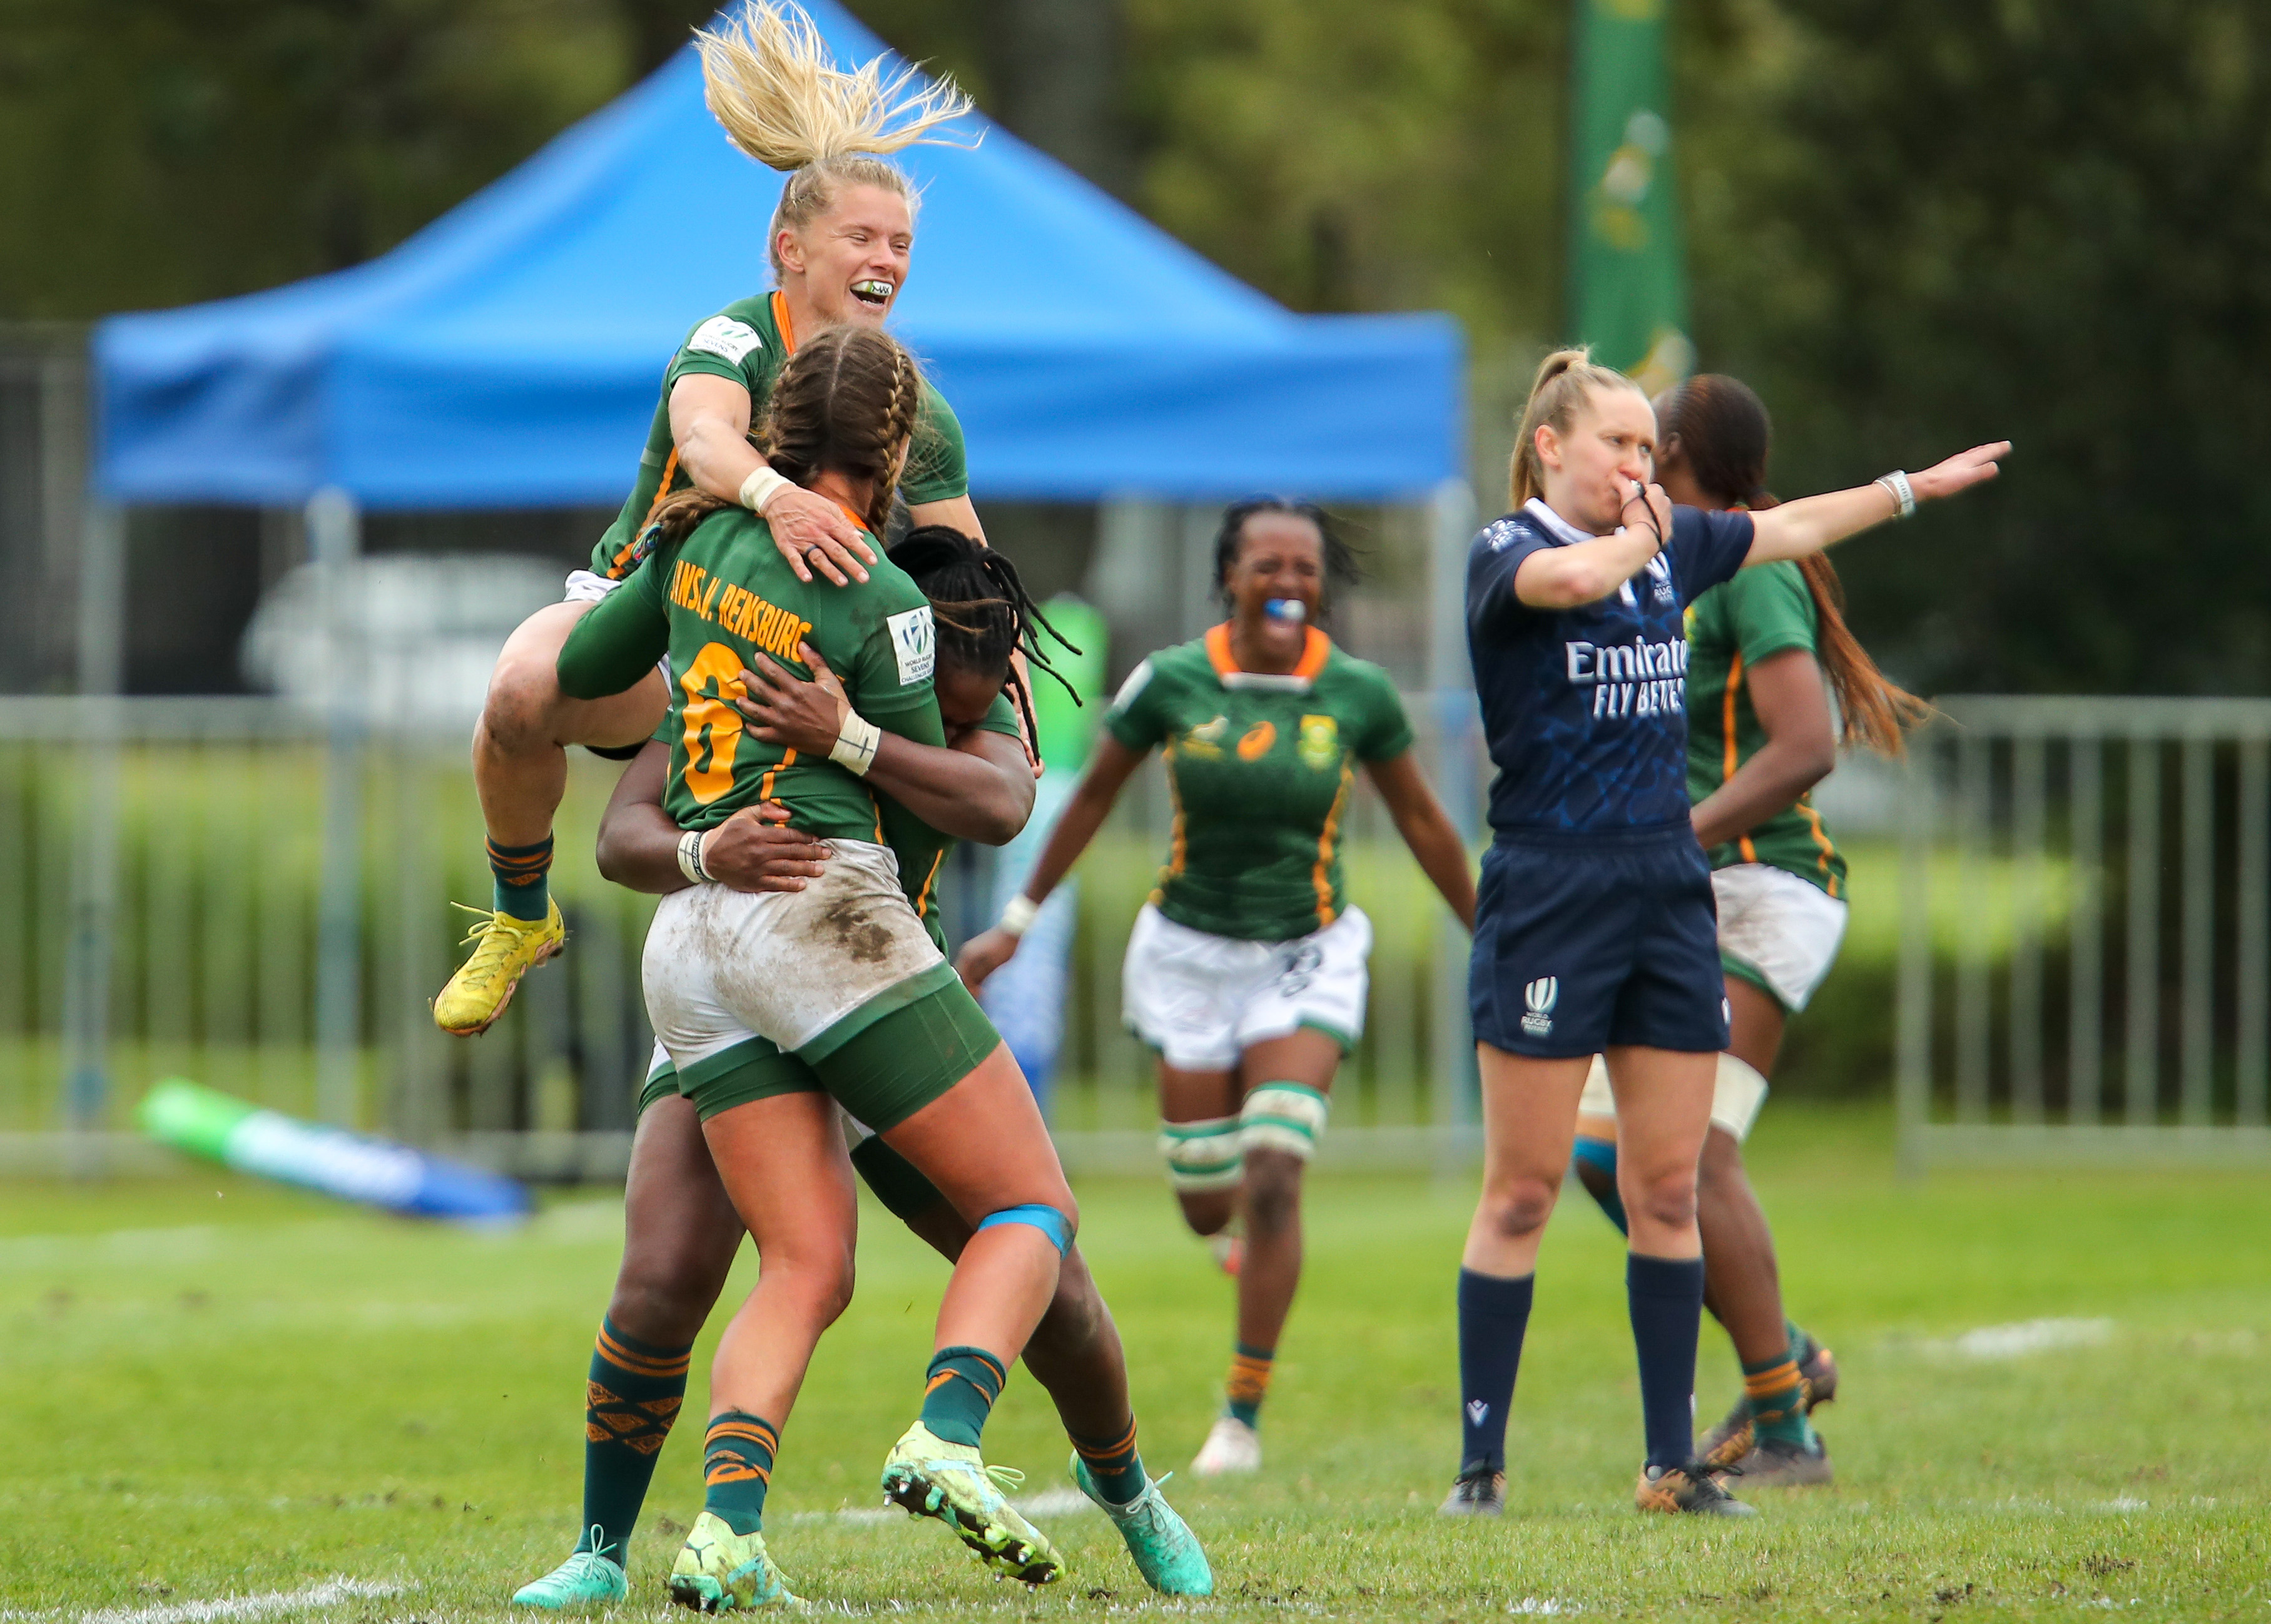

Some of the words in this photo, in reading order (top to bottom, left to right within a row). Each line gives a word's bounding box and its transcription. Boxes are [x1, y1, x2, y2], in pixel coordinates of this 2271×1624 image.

[718, 582, 812, 663] RENSBURG
[911, 661, 930, 674] SEVENS
[1565, 634, 1689, 682] Emirate
[680, 641, 748, 804] 6
[1593, 682, 1635, 719] FLY
